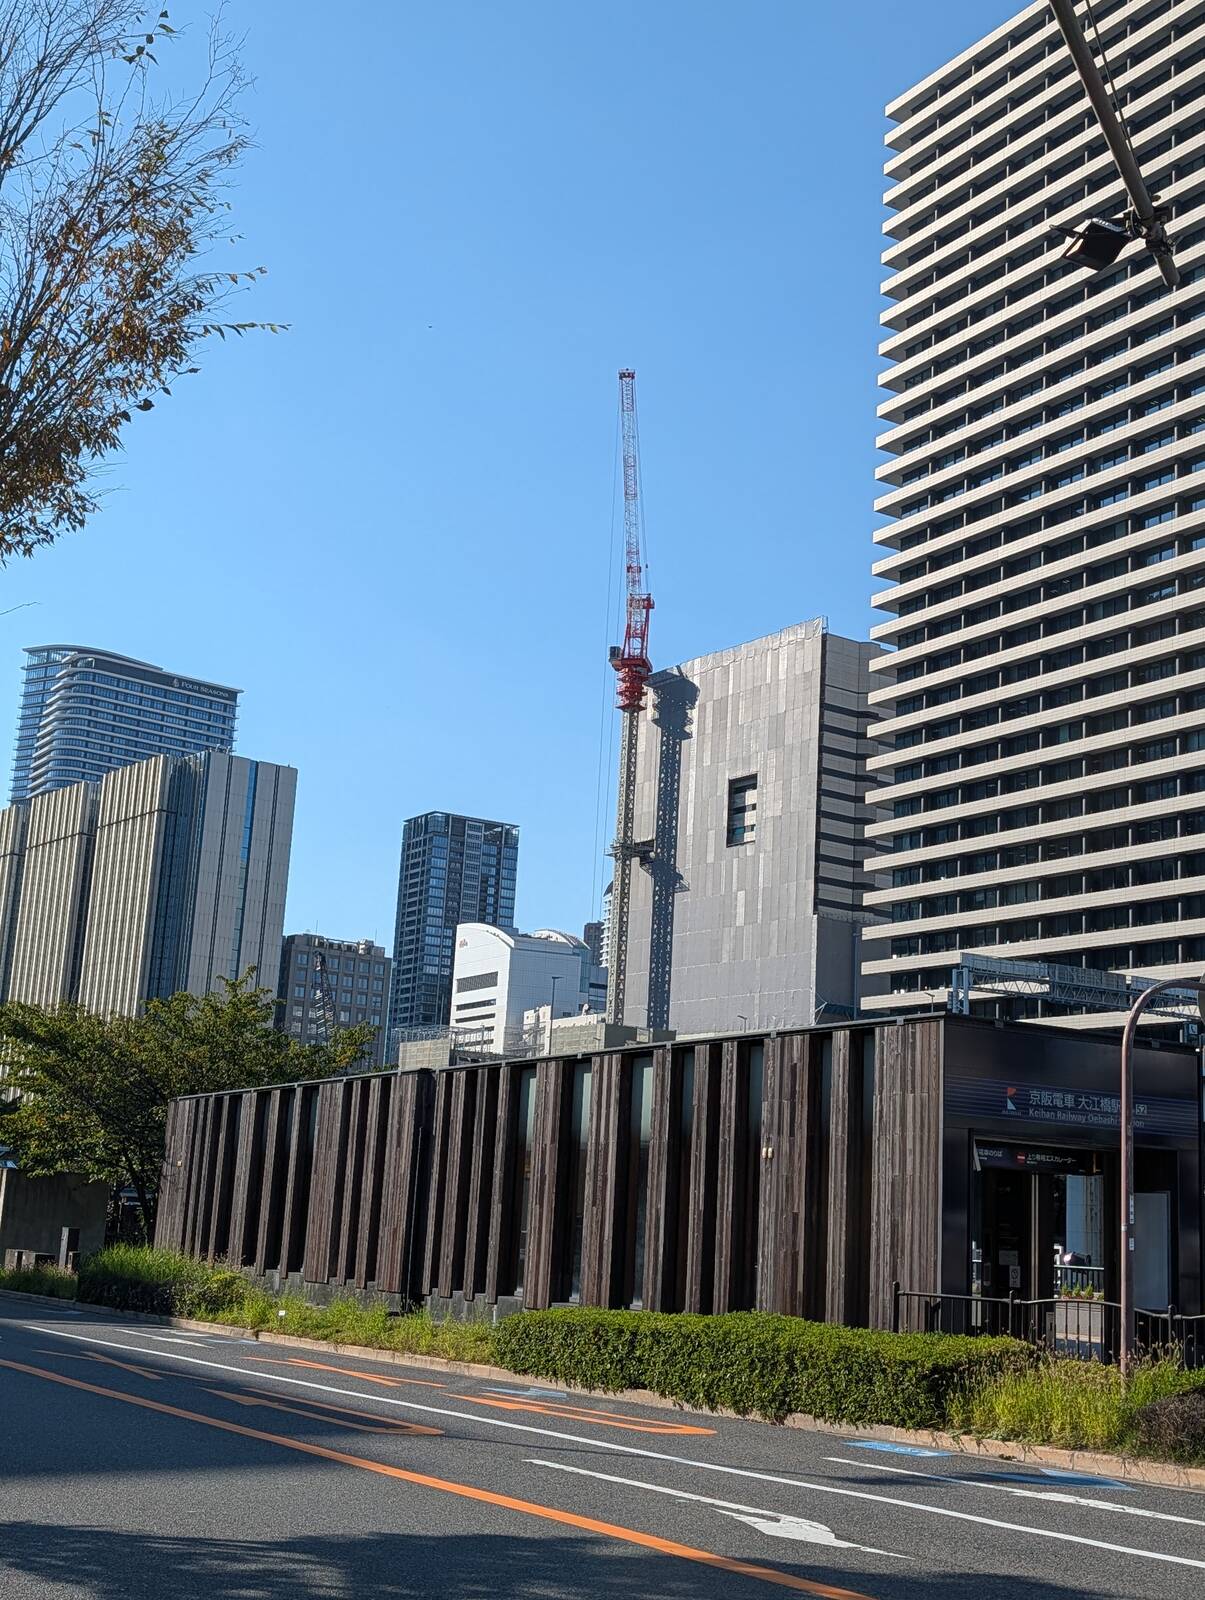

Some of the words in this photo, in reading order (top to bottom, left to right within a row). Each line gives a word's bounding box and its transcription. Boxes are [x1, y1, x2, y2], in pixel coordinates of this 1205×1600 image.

[181, 681, 199, 691] FOUR
[200, 685, 229, 697] SEASONS
[1029, 1090, 1075, 1108] 京阪電車
[1078, 1095, 1120, 1113] 大江橋駅
[1029, 1108, 1055, 1120] Keihan
[1057, 1110, 1087, 1124] Railway
